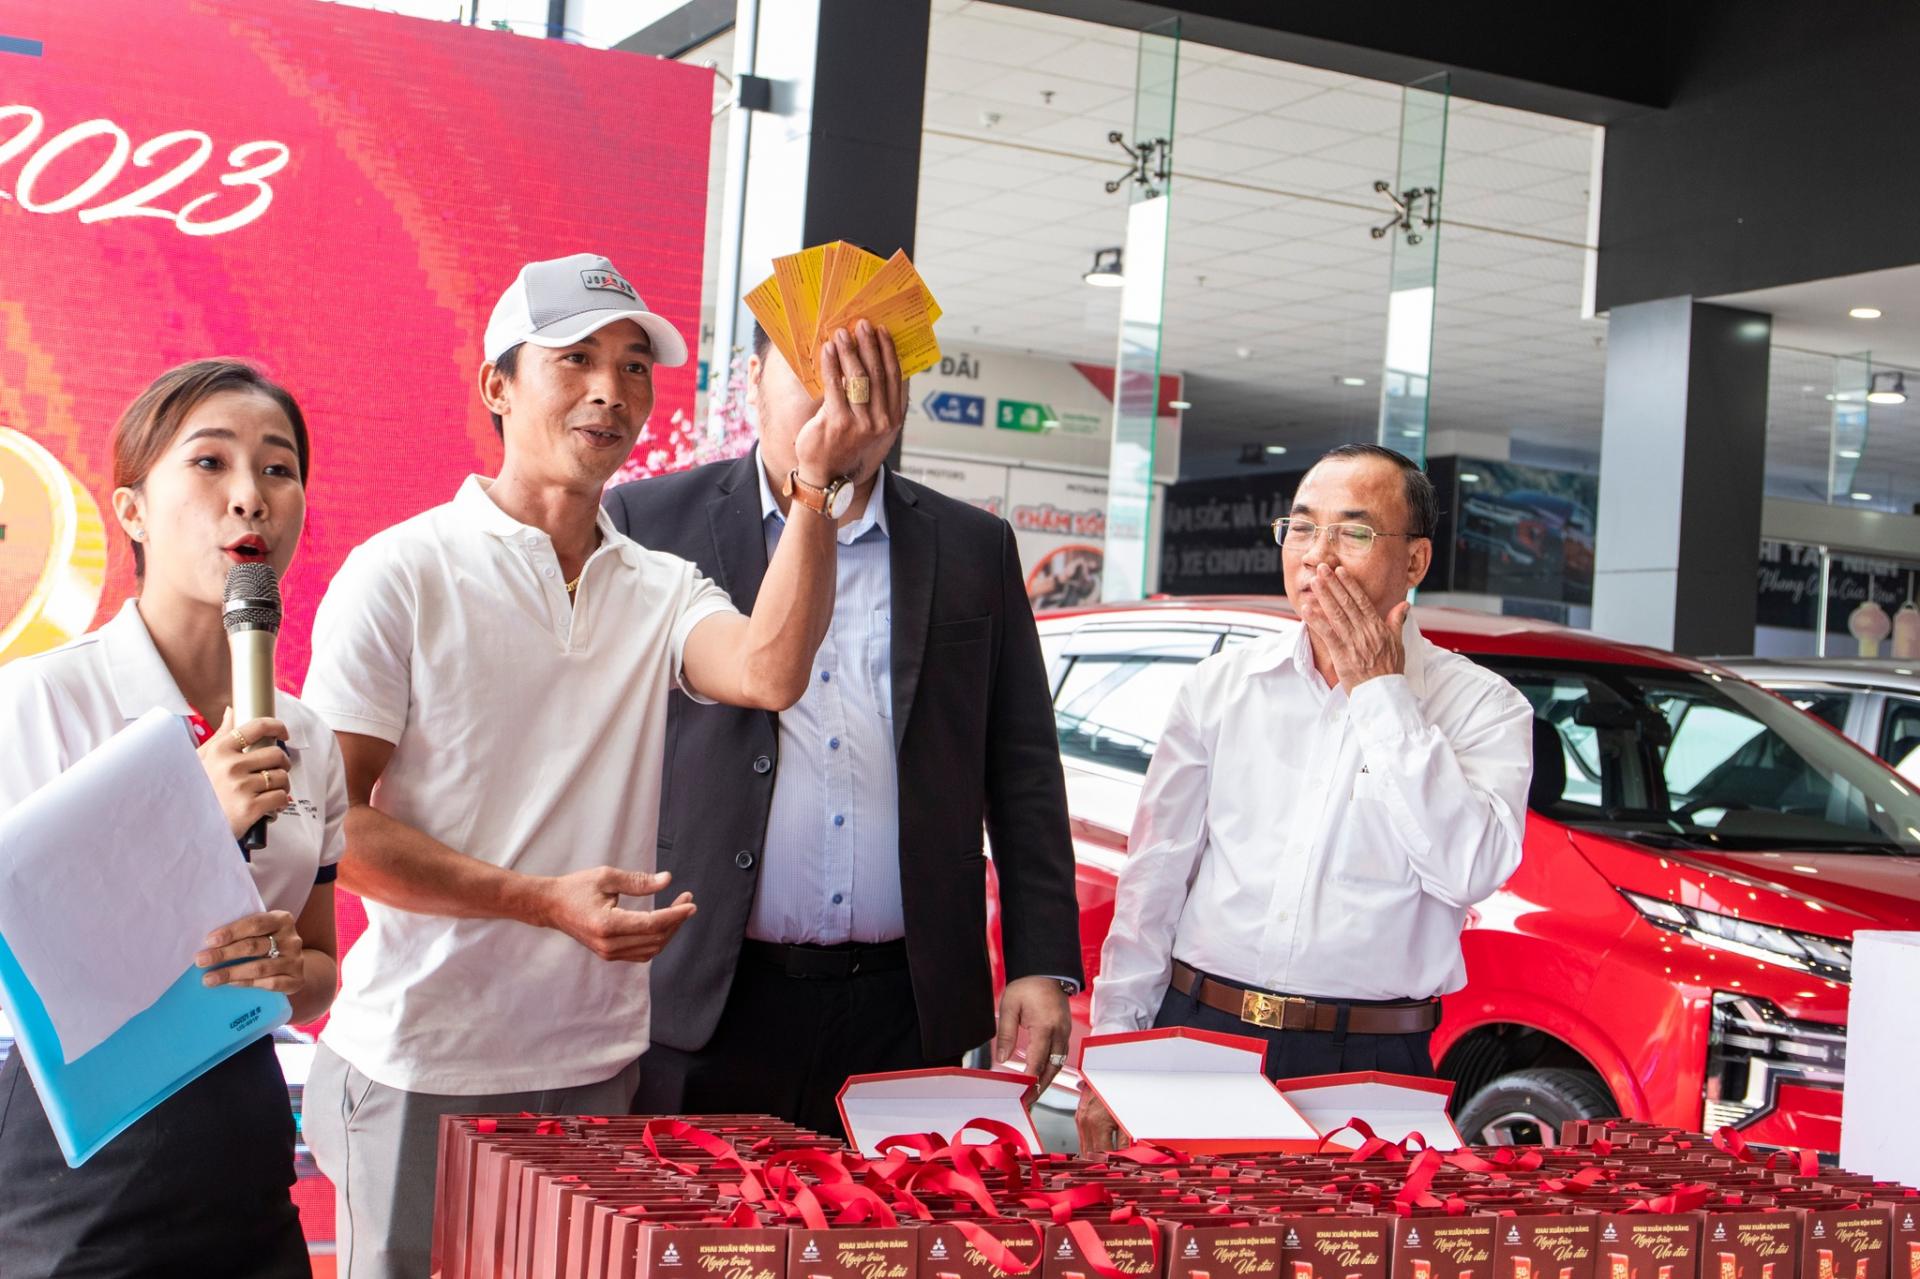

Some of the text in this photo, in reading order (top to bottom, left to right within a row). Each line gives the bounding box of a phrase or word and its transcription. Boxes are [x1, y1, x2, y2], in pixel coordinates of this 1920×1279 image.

[940, 353, 980, 379] ĐÃI
[966, 402, 980, 419] 4
[1002, 406, 1014, 423] 5
